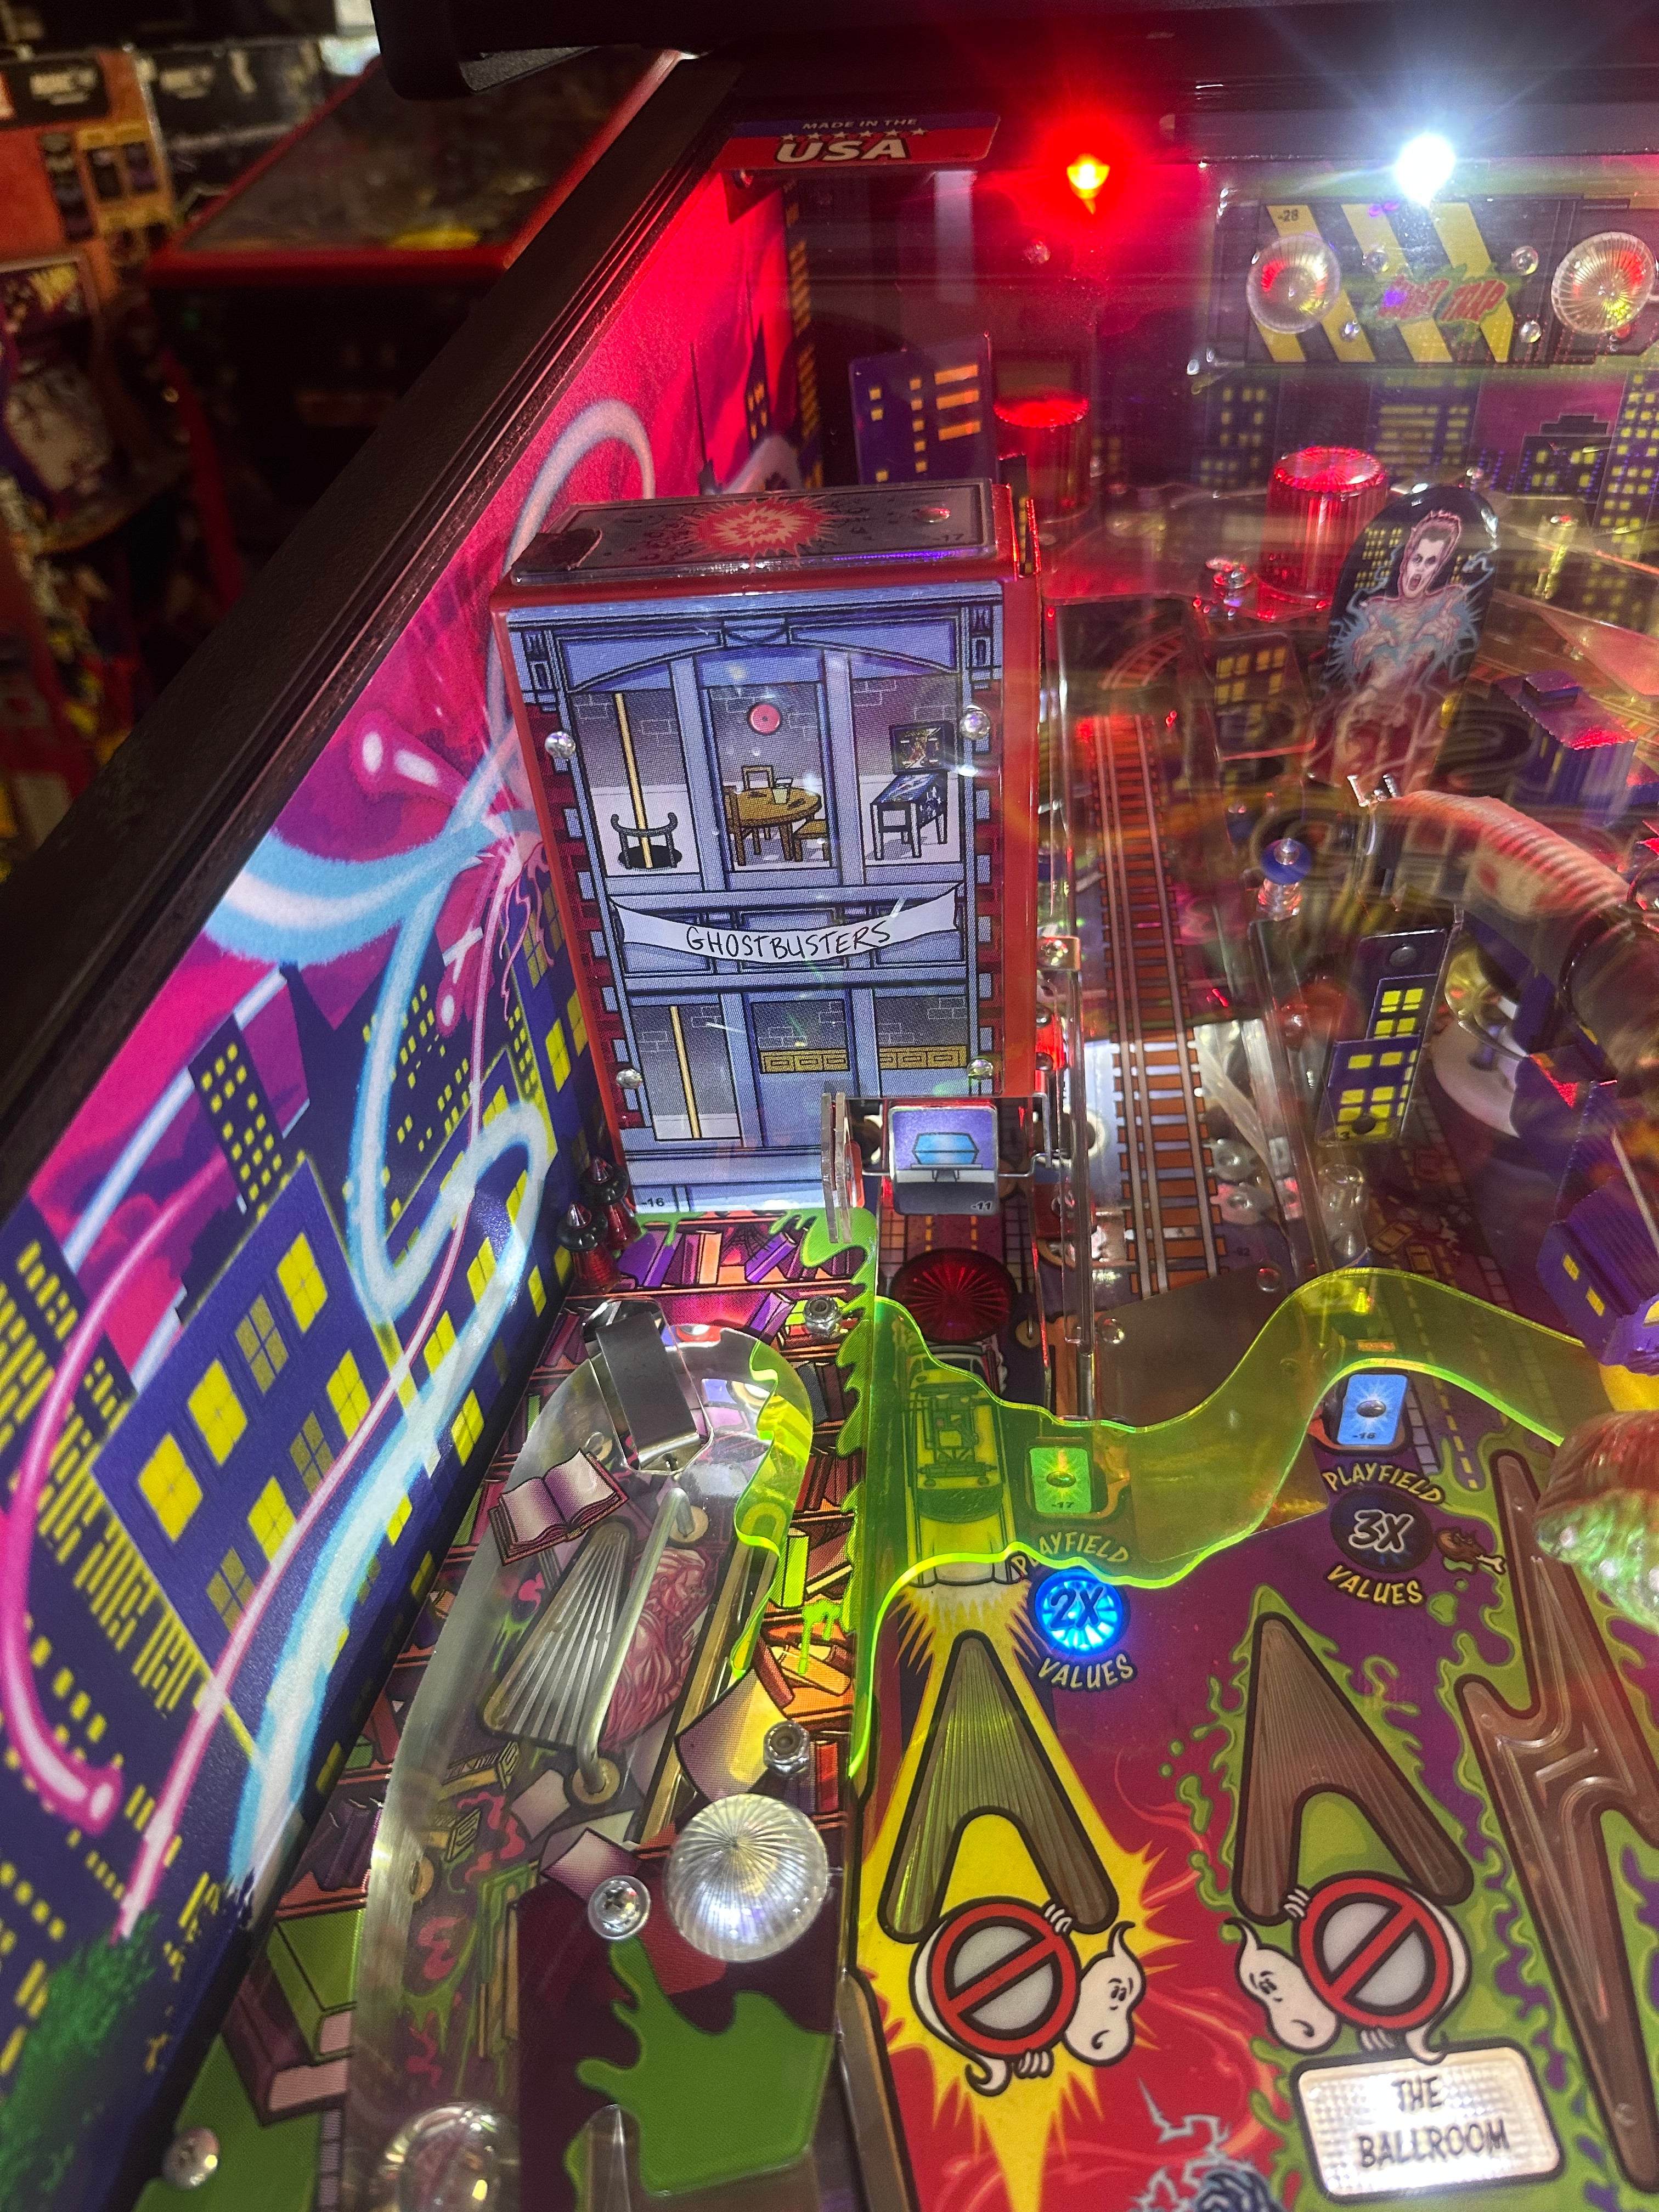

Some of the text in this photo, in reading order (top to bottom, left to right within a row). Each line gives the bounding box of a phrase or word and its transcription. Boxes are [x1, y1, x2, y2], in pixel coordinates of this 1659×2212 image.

[777, 139, 907, 163] USA
[686, 920, 890, 960] GHOSTBUSTERS
[641, 1197, 665, 1207] -16
[971, 1201, 991, 1210] -11
[1322, 1463, 1441, 1502] PLAYFIELD
[1348, 1509, 1415, 1553] 3X
[1328, 1565, 1423, 1604] VALUES
[1050, 1585, 1104, 1629] 2X
[1038, 1653, 1133, 1689] VALUES
[1391, 2075, 1444, 2112] THE
[1357, 2118, 1510, 2169] BALLROOM
